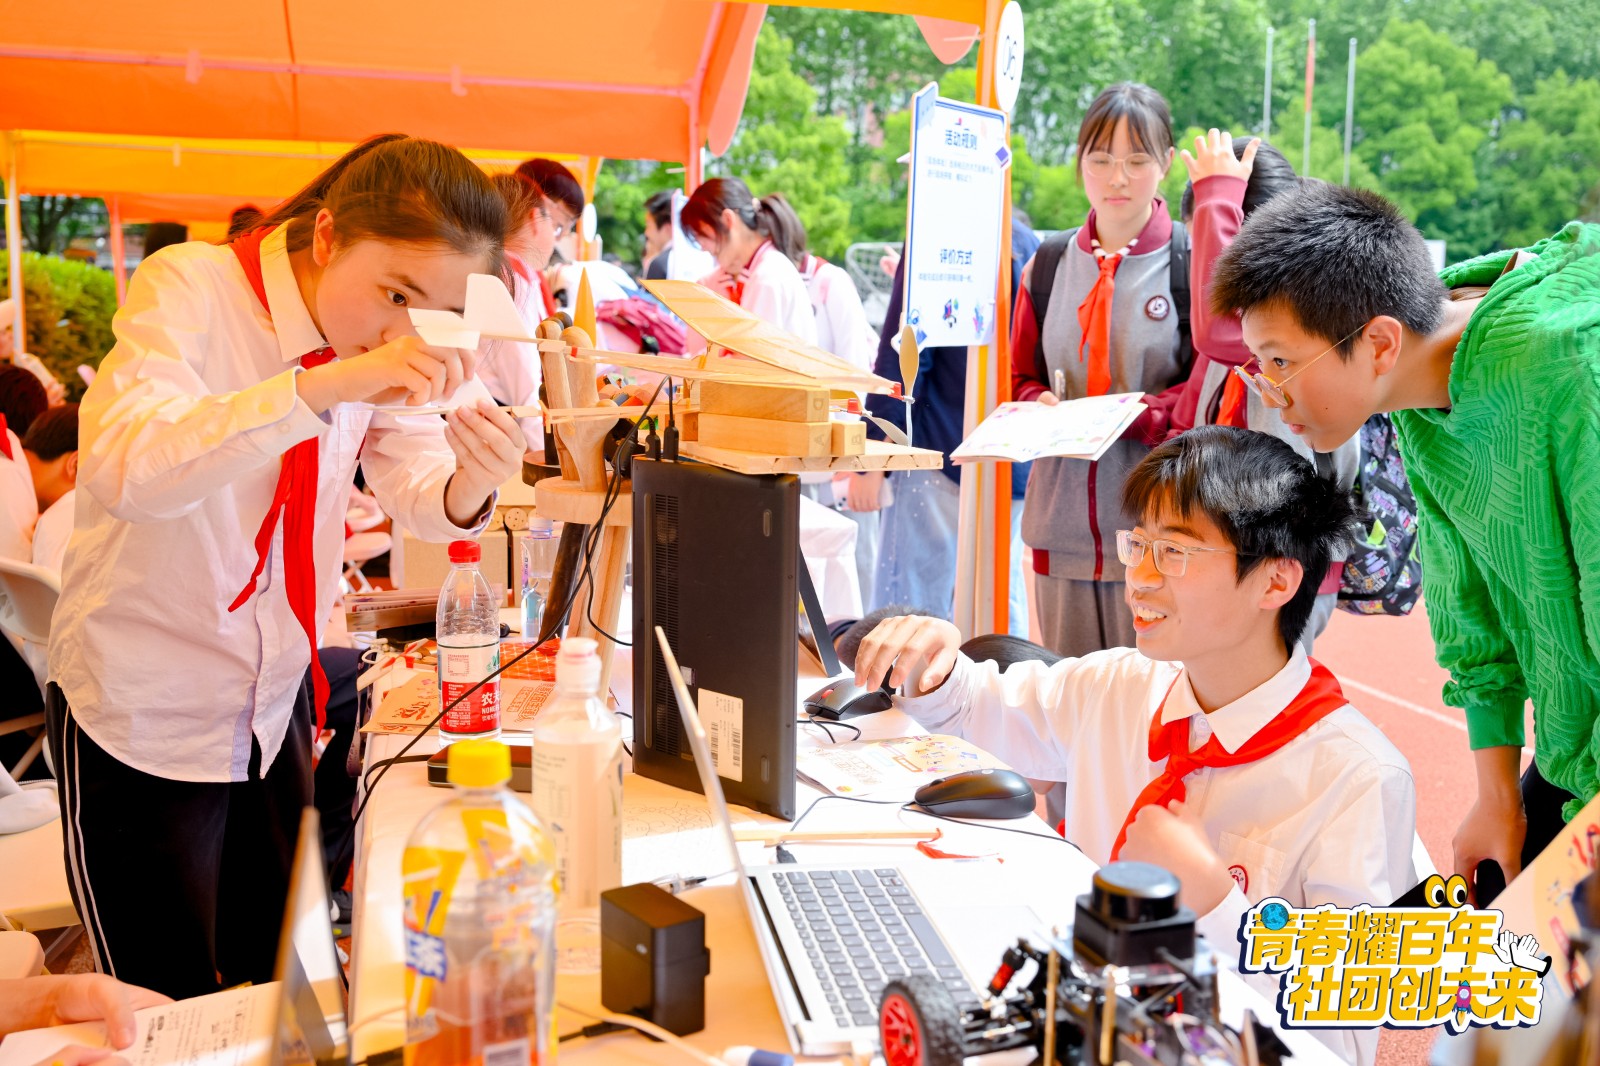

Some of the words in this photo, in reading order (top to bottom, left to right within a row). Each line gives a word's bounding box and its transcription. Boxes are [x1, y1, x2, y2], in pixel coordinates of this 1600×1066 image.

[945, 129, 978, 150] 活动规则
[940, 248, 973, 265] 评价方式
